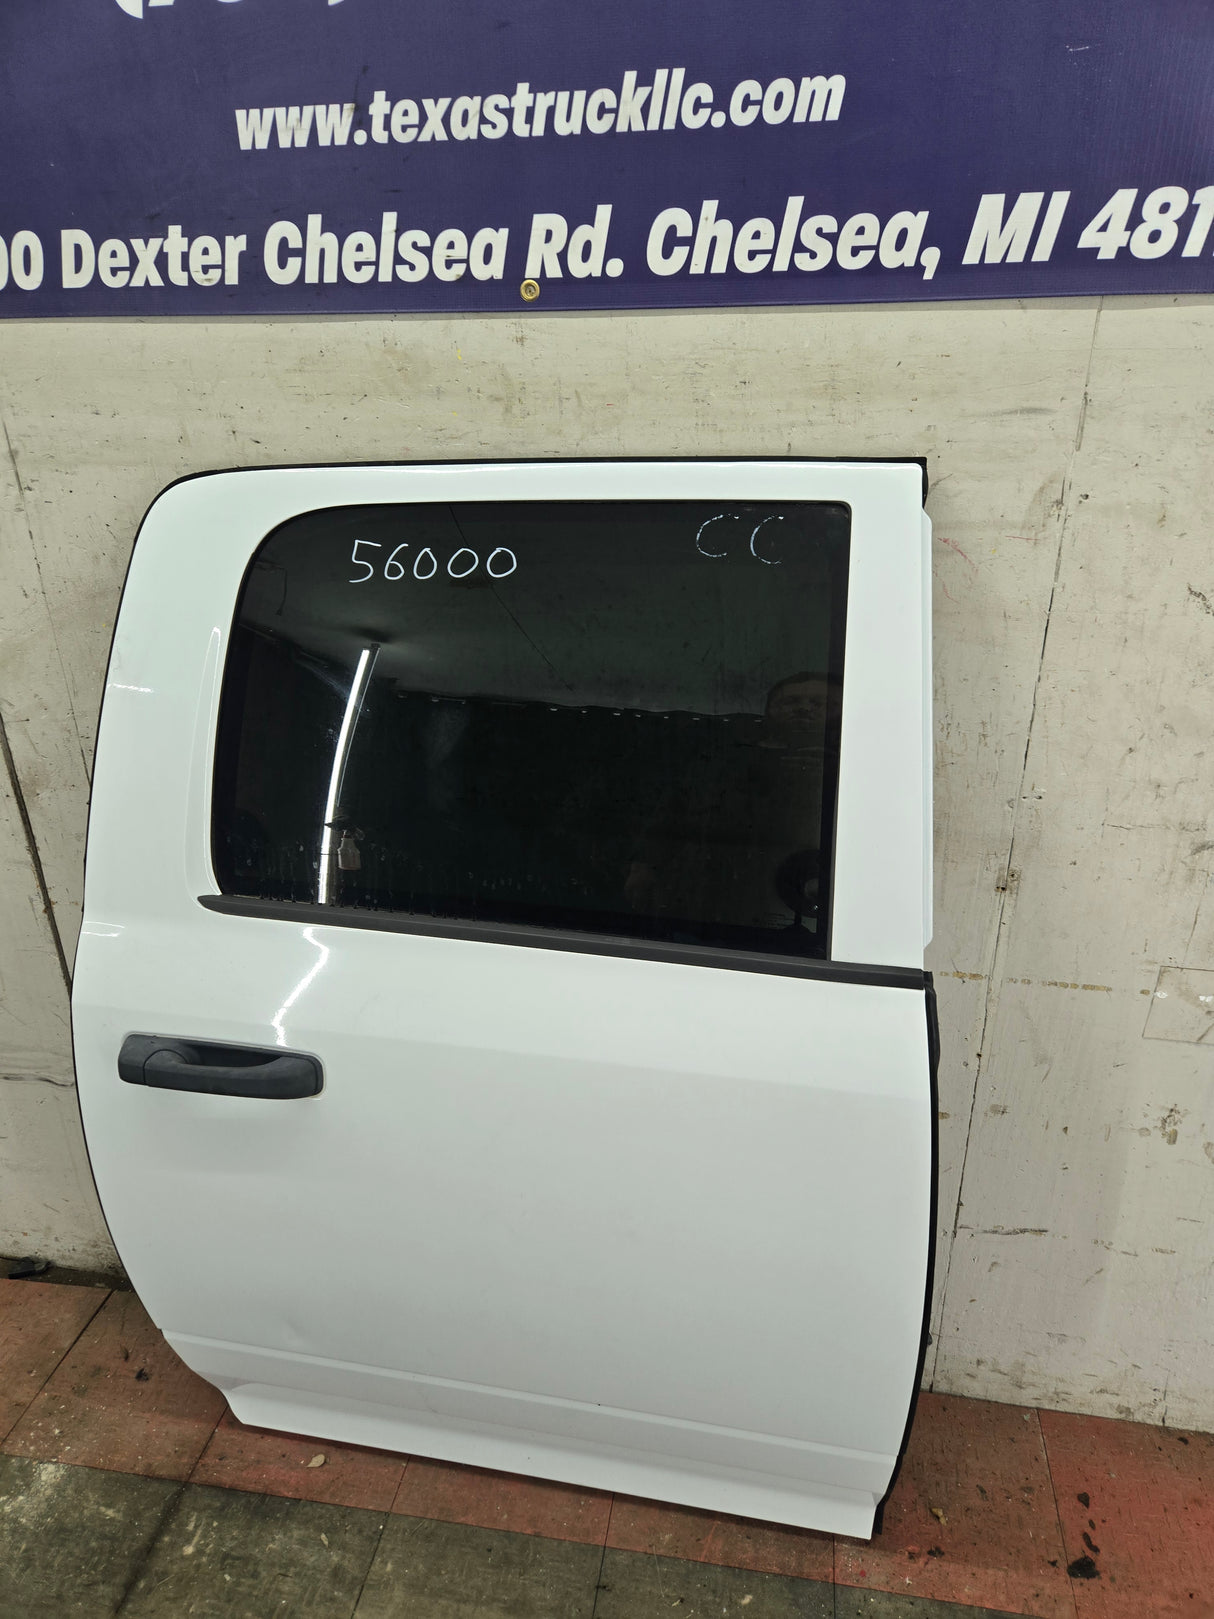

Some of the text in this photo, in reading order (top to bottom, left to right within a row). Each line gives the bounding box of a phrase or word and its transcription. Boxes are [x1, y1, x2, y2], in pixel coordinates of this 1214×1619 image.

[235, 68, 847, 151] www.texastruckllc.com
[0, 185, 1214, 291] 0 Dexter Chelsea Rd. Chelsea, MI 481
[348, 539, 518, 584] 56000
